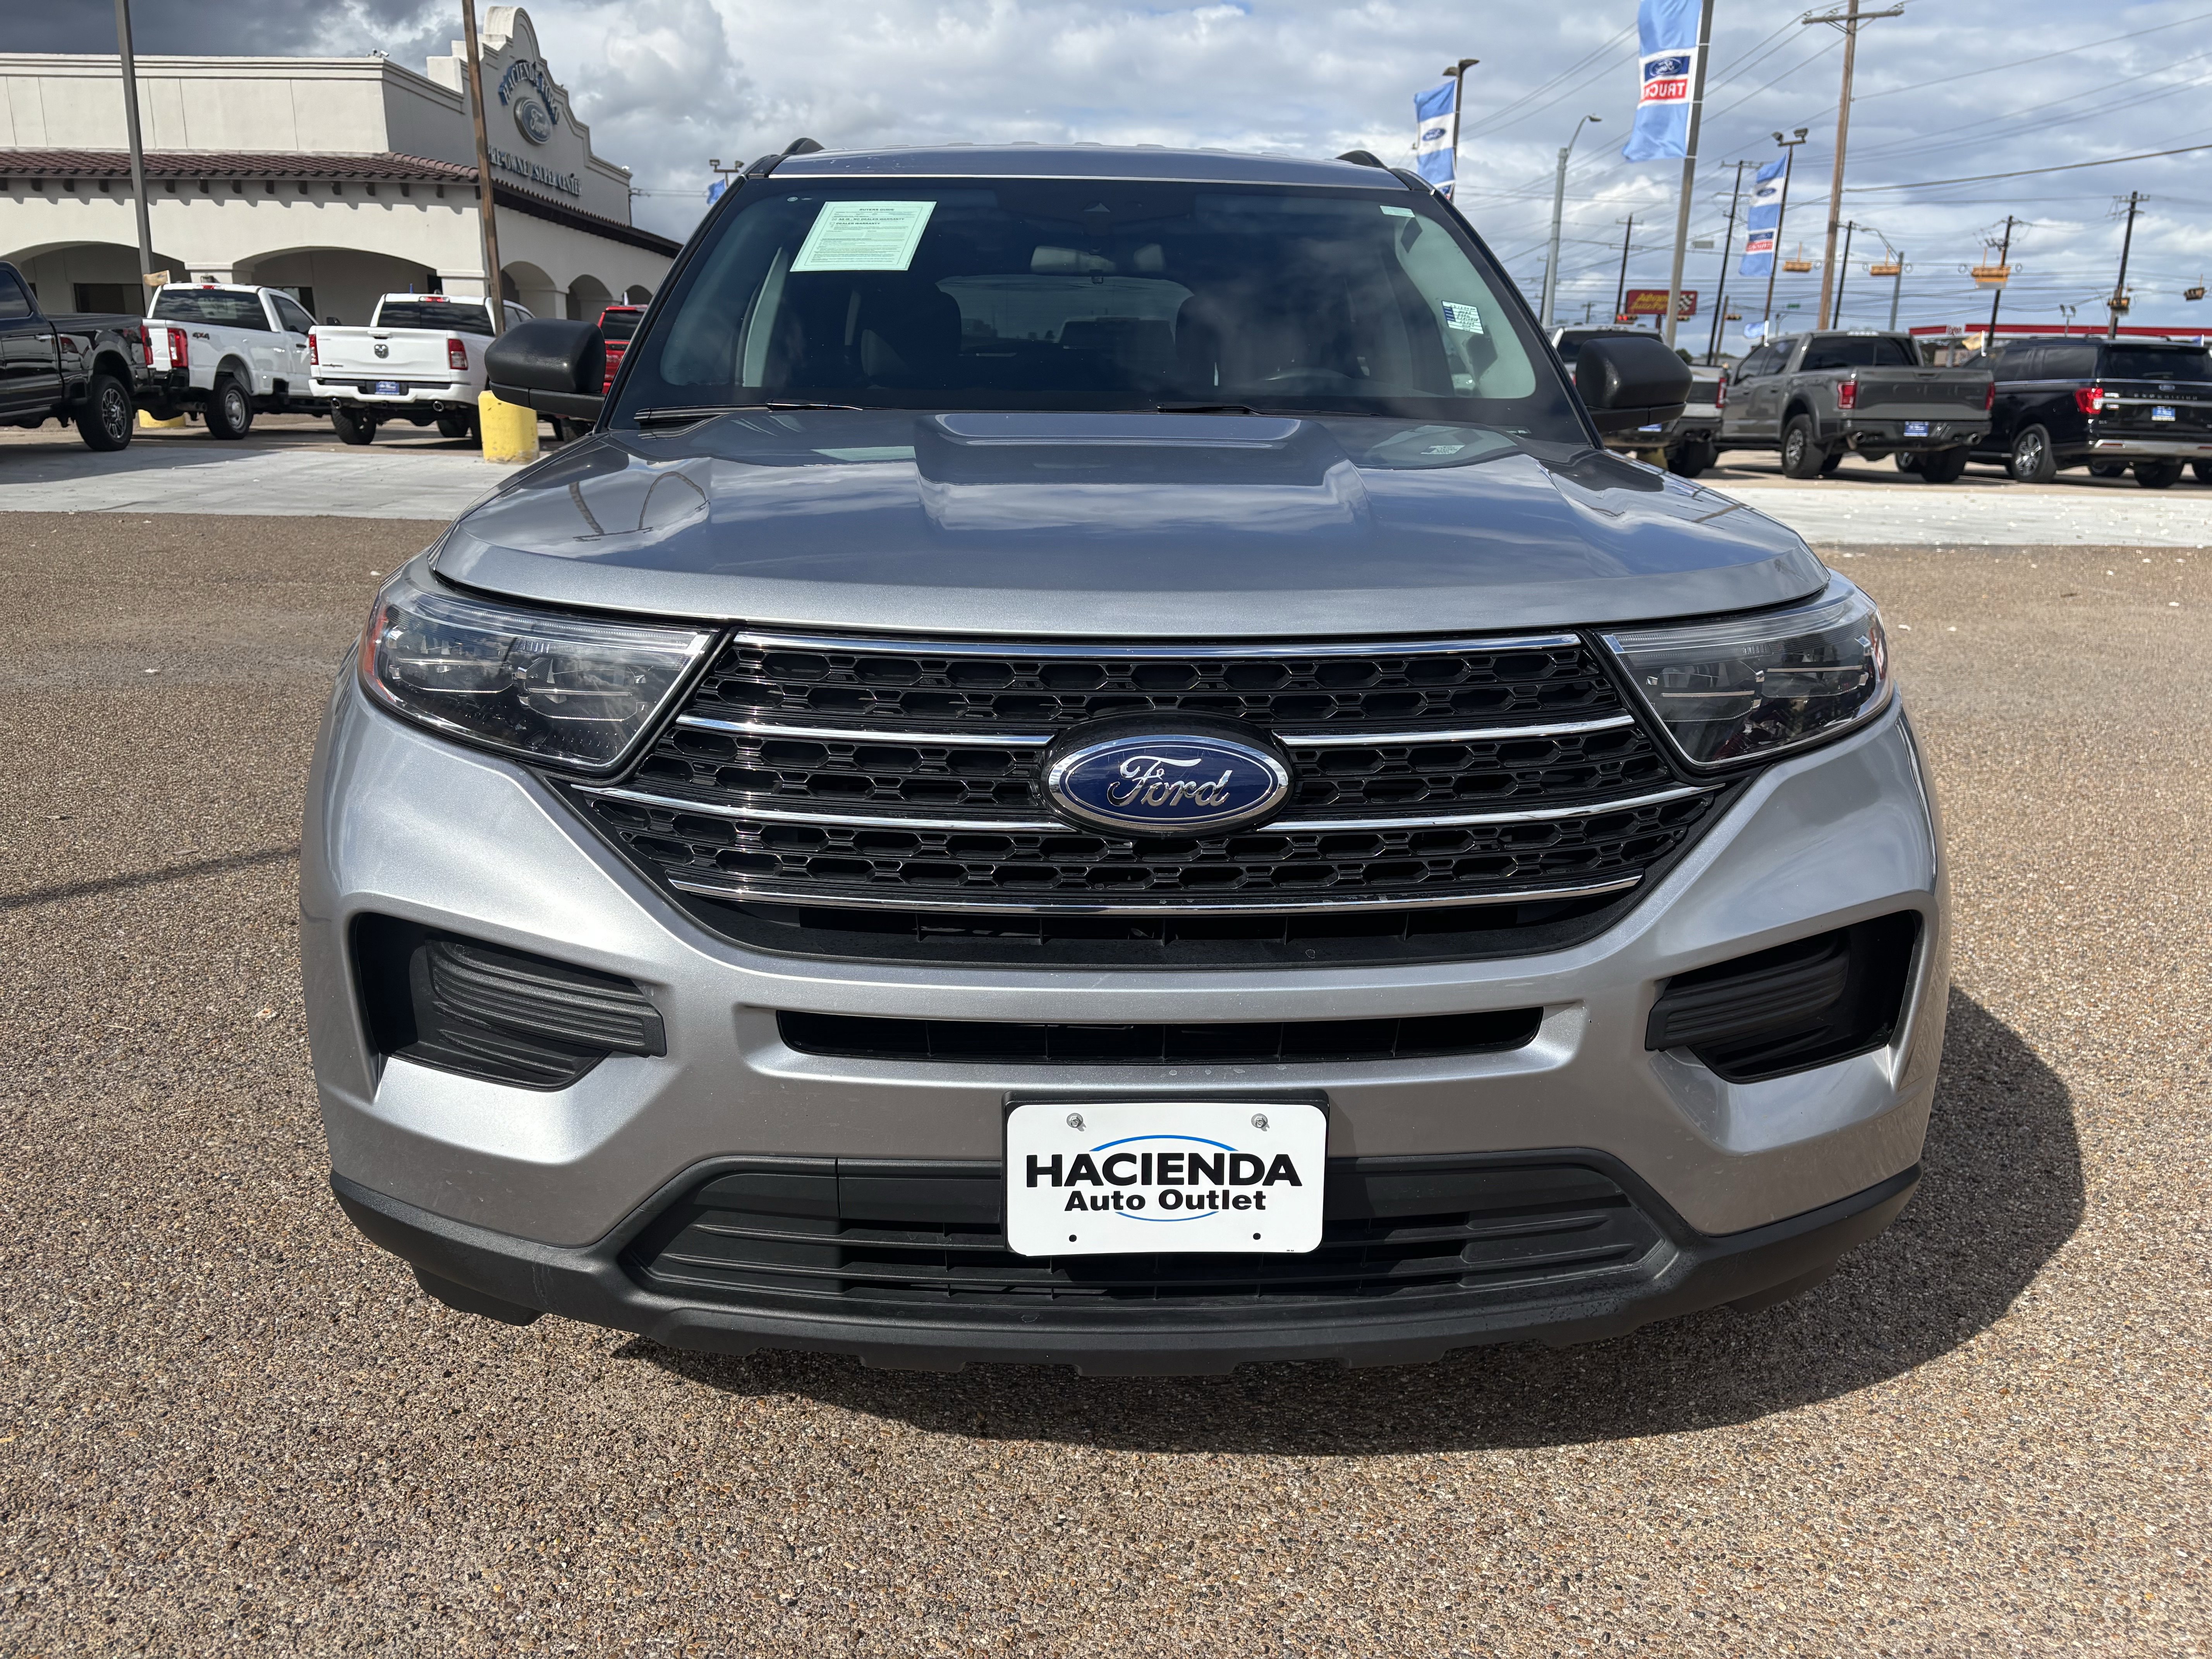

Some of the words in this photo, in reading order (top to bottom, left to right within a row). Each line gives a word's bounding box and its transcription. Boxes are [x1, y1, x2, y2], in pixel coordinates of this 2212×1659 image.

[501, 61, 539, 105] HACIENDA
[533, 163, 558, 187] SUPER
[558, 174, 582, 196] CENTER
[1107, 755, 1233, 807] Ford
[1026, 1152, 1302, 1188] HACIENDA
[1065, 1190, 1146, 1211] Auto
[1158, 1188, 1266, 1211] Outlet
